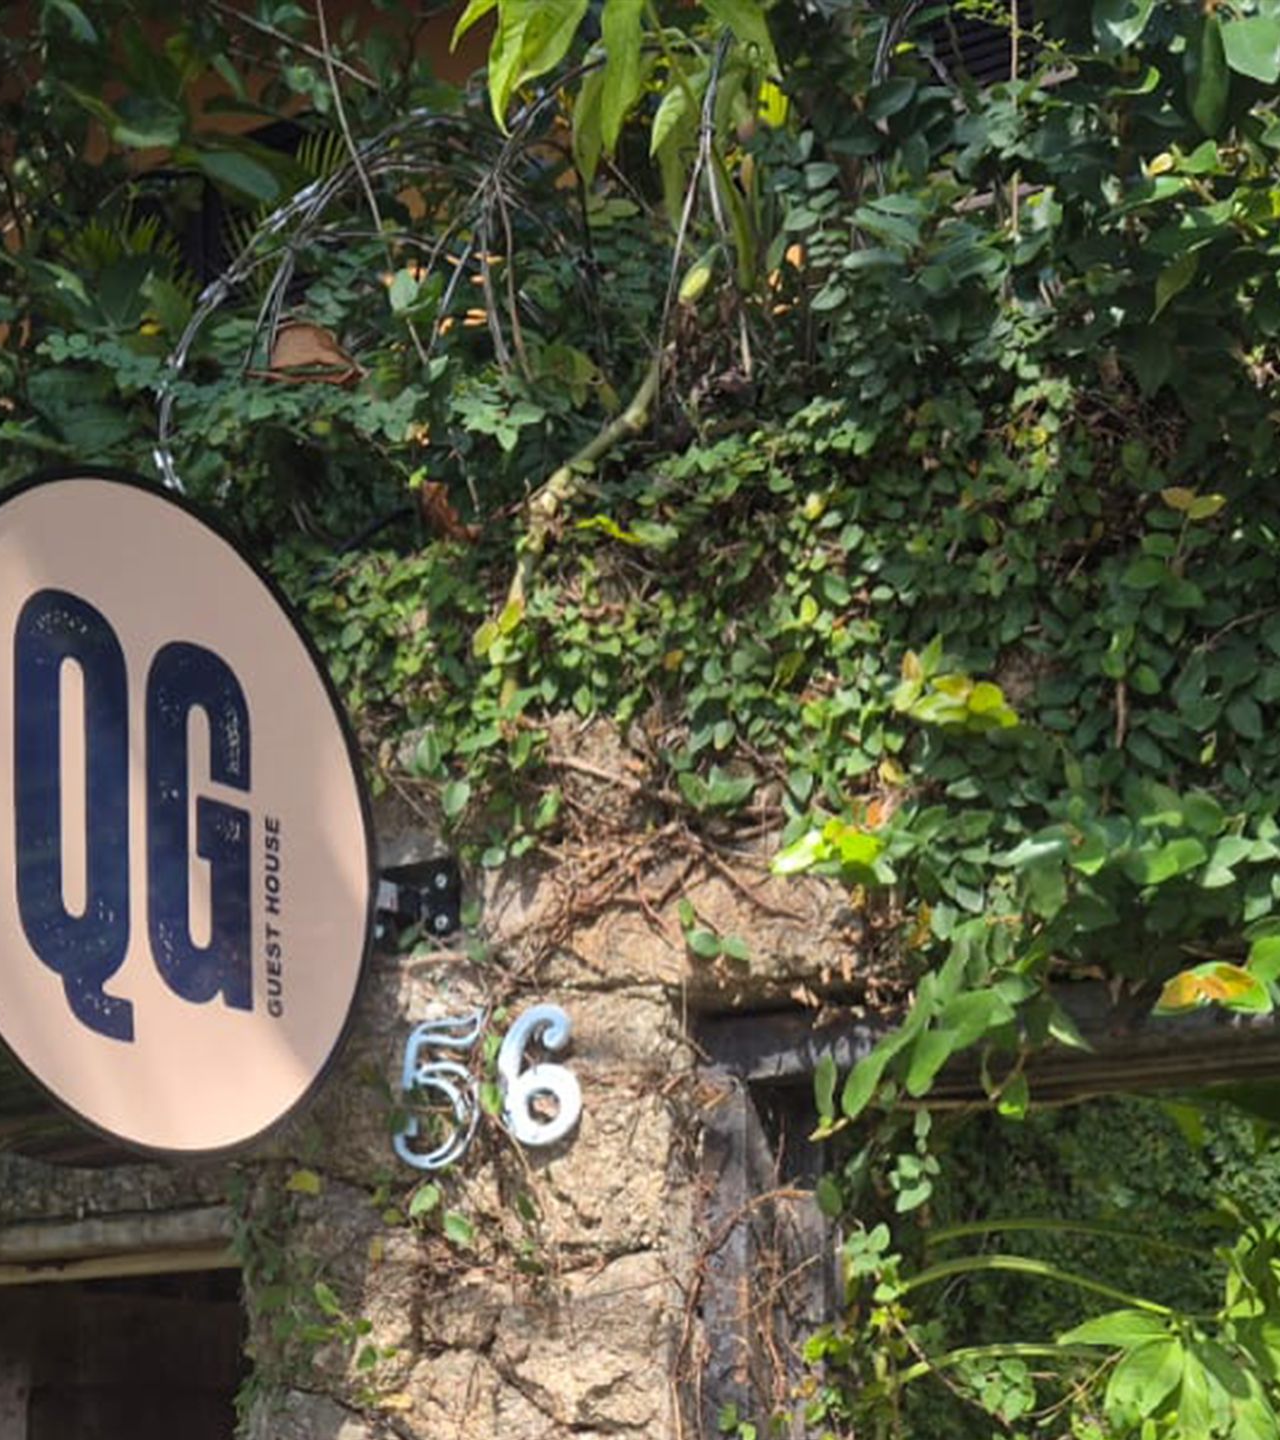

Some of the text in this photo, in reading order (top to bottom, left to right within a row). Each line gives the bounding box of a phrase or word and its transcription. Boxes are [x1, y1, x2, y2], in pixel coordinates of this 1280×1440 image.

[13, 587, 254, 1043] QG
[264, 815, 284, 1018] GUEST HOUSE
[393, 1004, 582, 1169] 56
